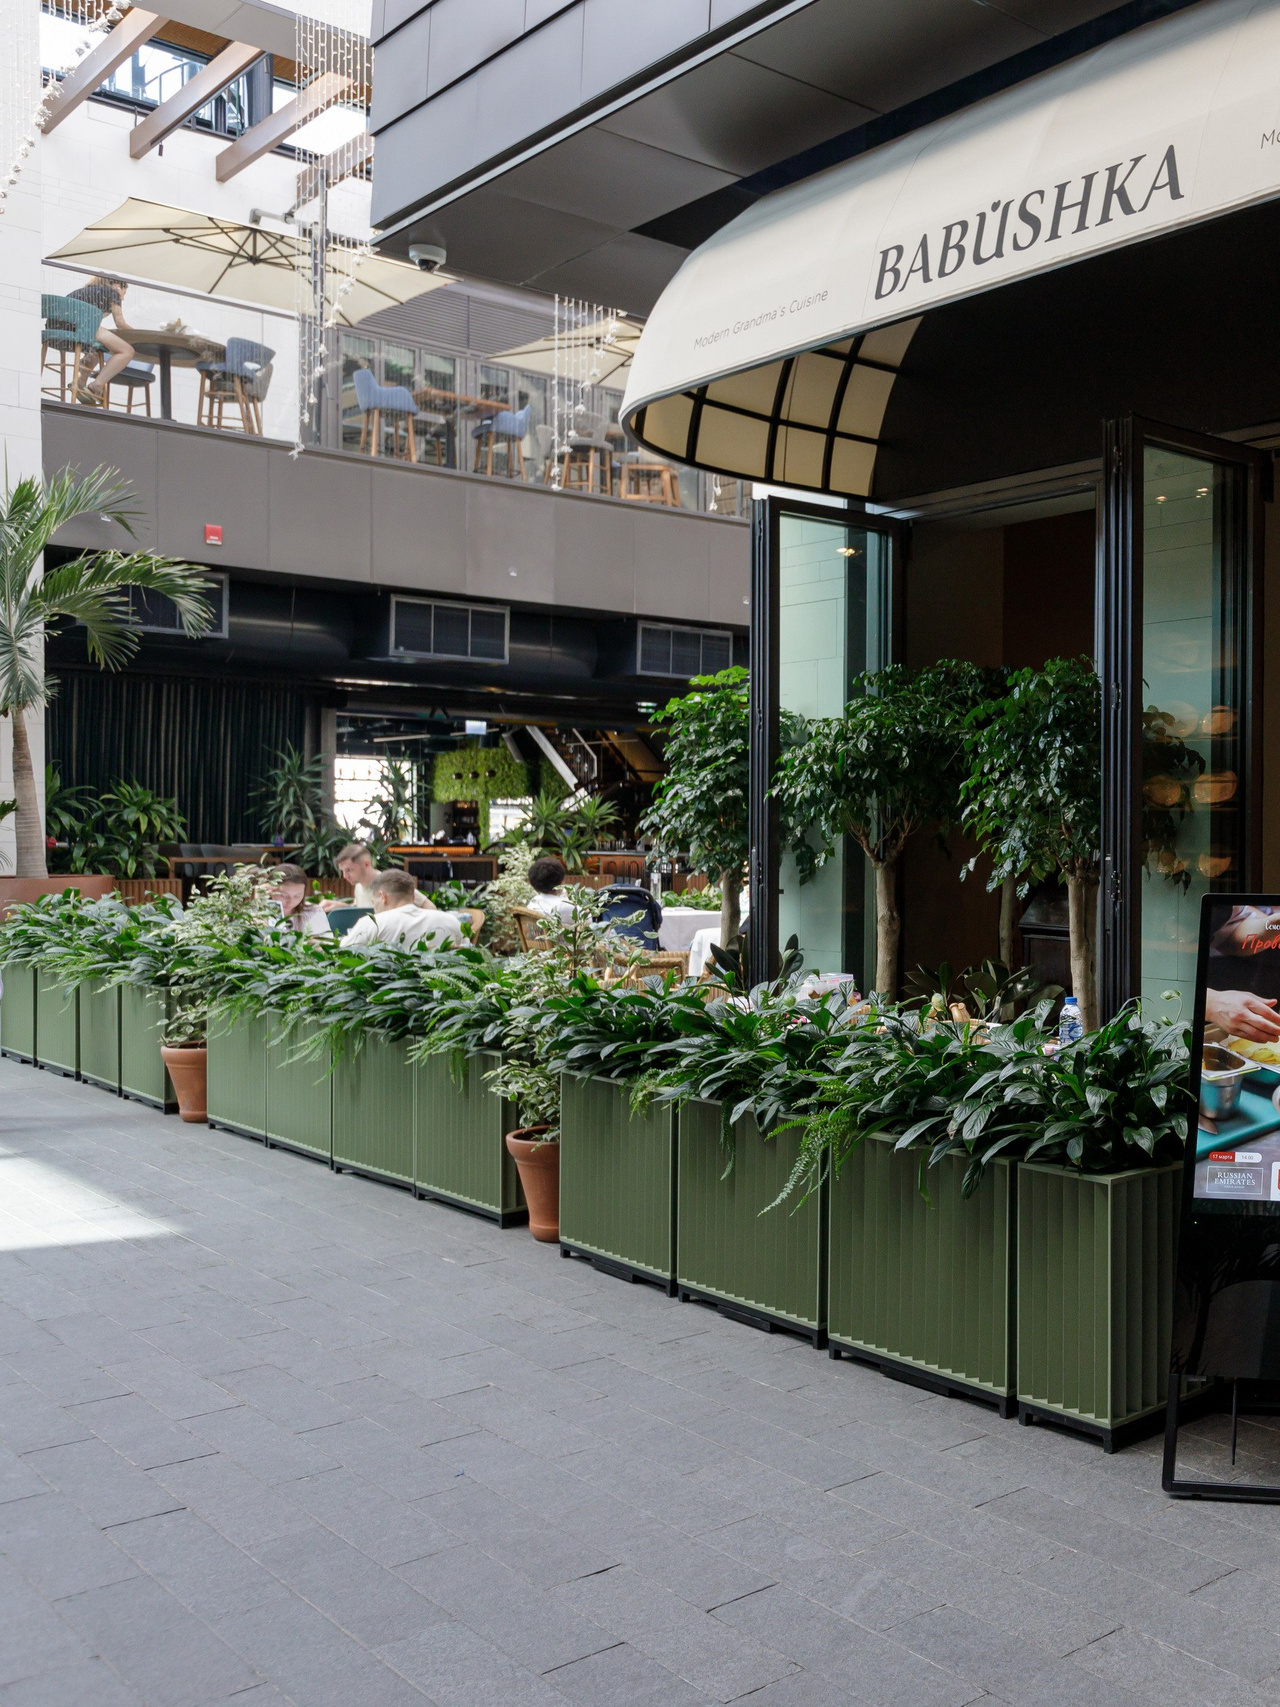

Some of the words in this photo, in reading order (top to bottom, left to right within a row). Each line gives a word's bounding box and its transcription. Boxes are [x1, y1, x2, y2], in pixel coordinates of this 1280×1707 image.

[693, 328, 730, 350] Modern
[732, 305, 786, 334] Grandma's
[789, 290, 829, 313] Cuisine
[1217, 1171, 1253, 1179] RUSSIAN
[1214, 1178, 1256, 1186] EMIRATES
